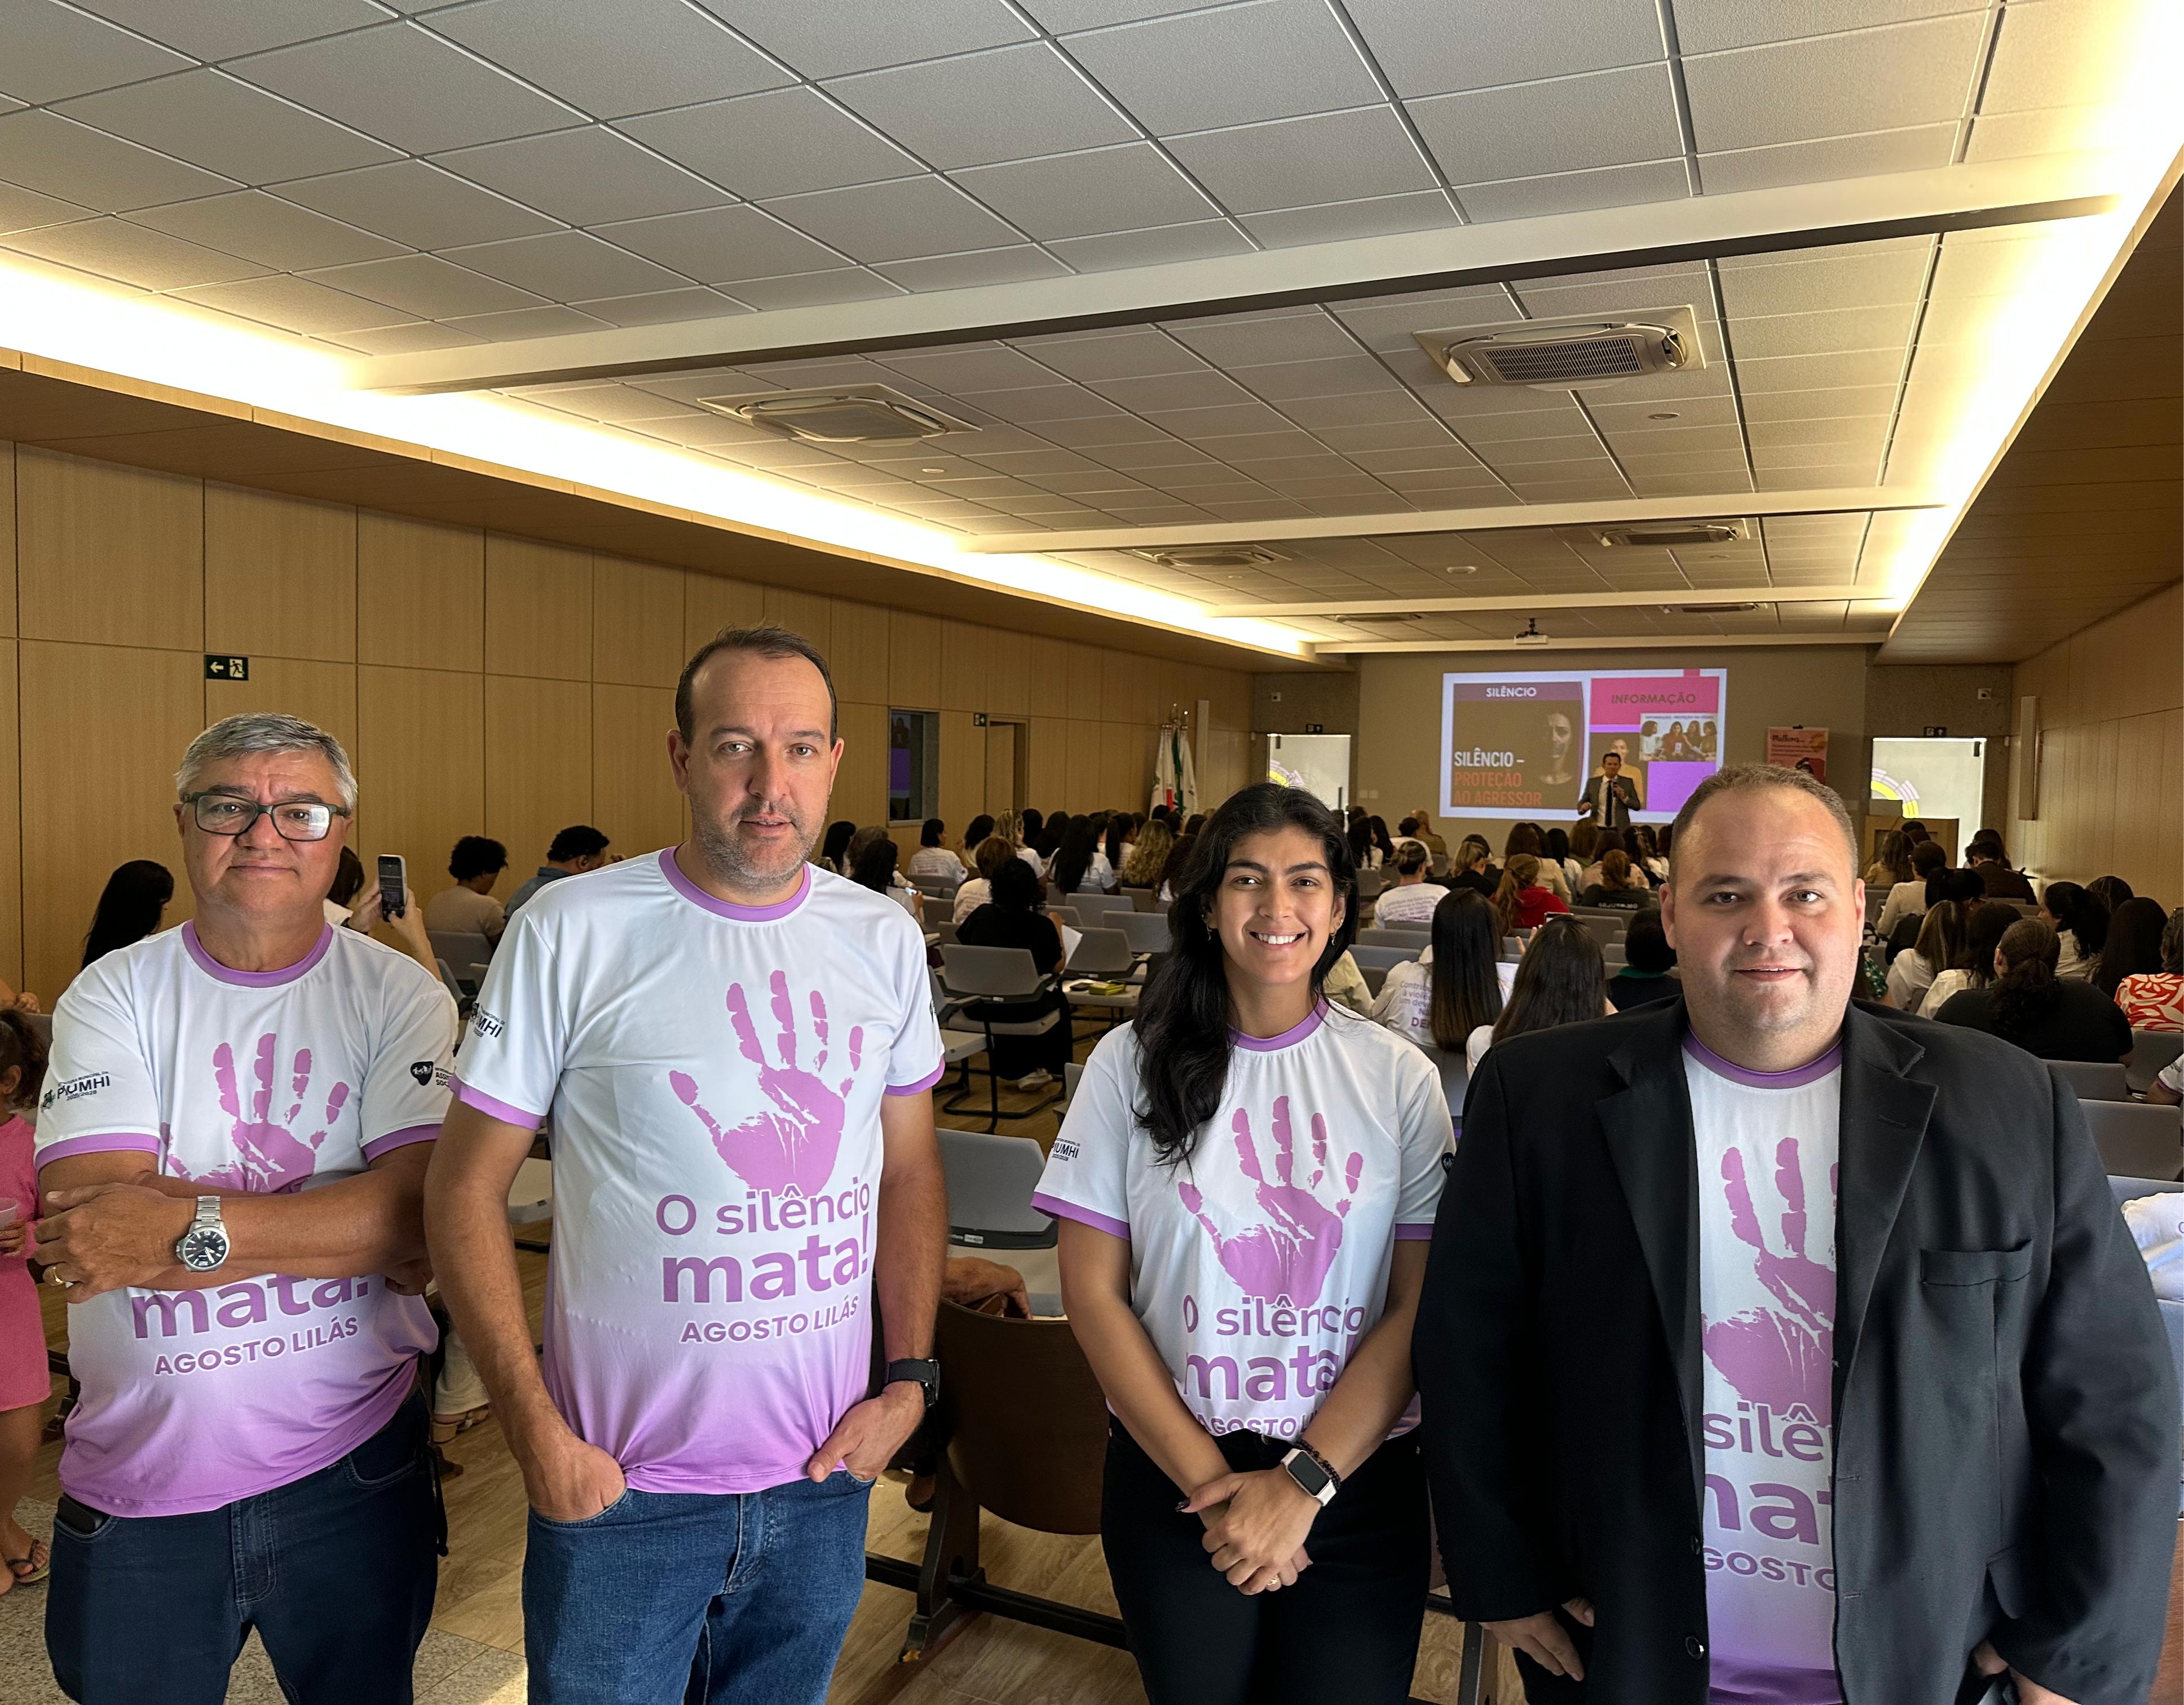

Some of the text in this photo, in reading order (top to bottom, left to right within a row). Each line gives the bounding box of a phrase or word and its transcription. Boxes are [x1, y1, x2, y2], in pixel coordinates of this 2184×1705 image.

[1486, 686, 1537, 698] SILÊNCIO
[1611, 692, 1696, 705] INFORMAÇÃO
[1454, 747, 1514, 767] SILÊNCIO
[1453, 769, 1522, 789] PROTEÇÃO
[1453, 790, 1542, 806] AO AGRESSOR
[57, 1075, 110, 1099] PIUMHI
[1053, 1142, 1079, 1159] IUMHI
[655, 1176, 870, 1235] O silêncio
[663, 1212, 869, 1303] mata!
[681, 1295, 858, 1342] AGOSTO LILÁS
[1184, 1295, 1365, 1337] O silêncio
[155, 1315, 359, 1375] AGOSTO LILÁS
[1704, 1402, 1832, 1461] silê
[1704, 1548, 1834, 1591] GOSTO
